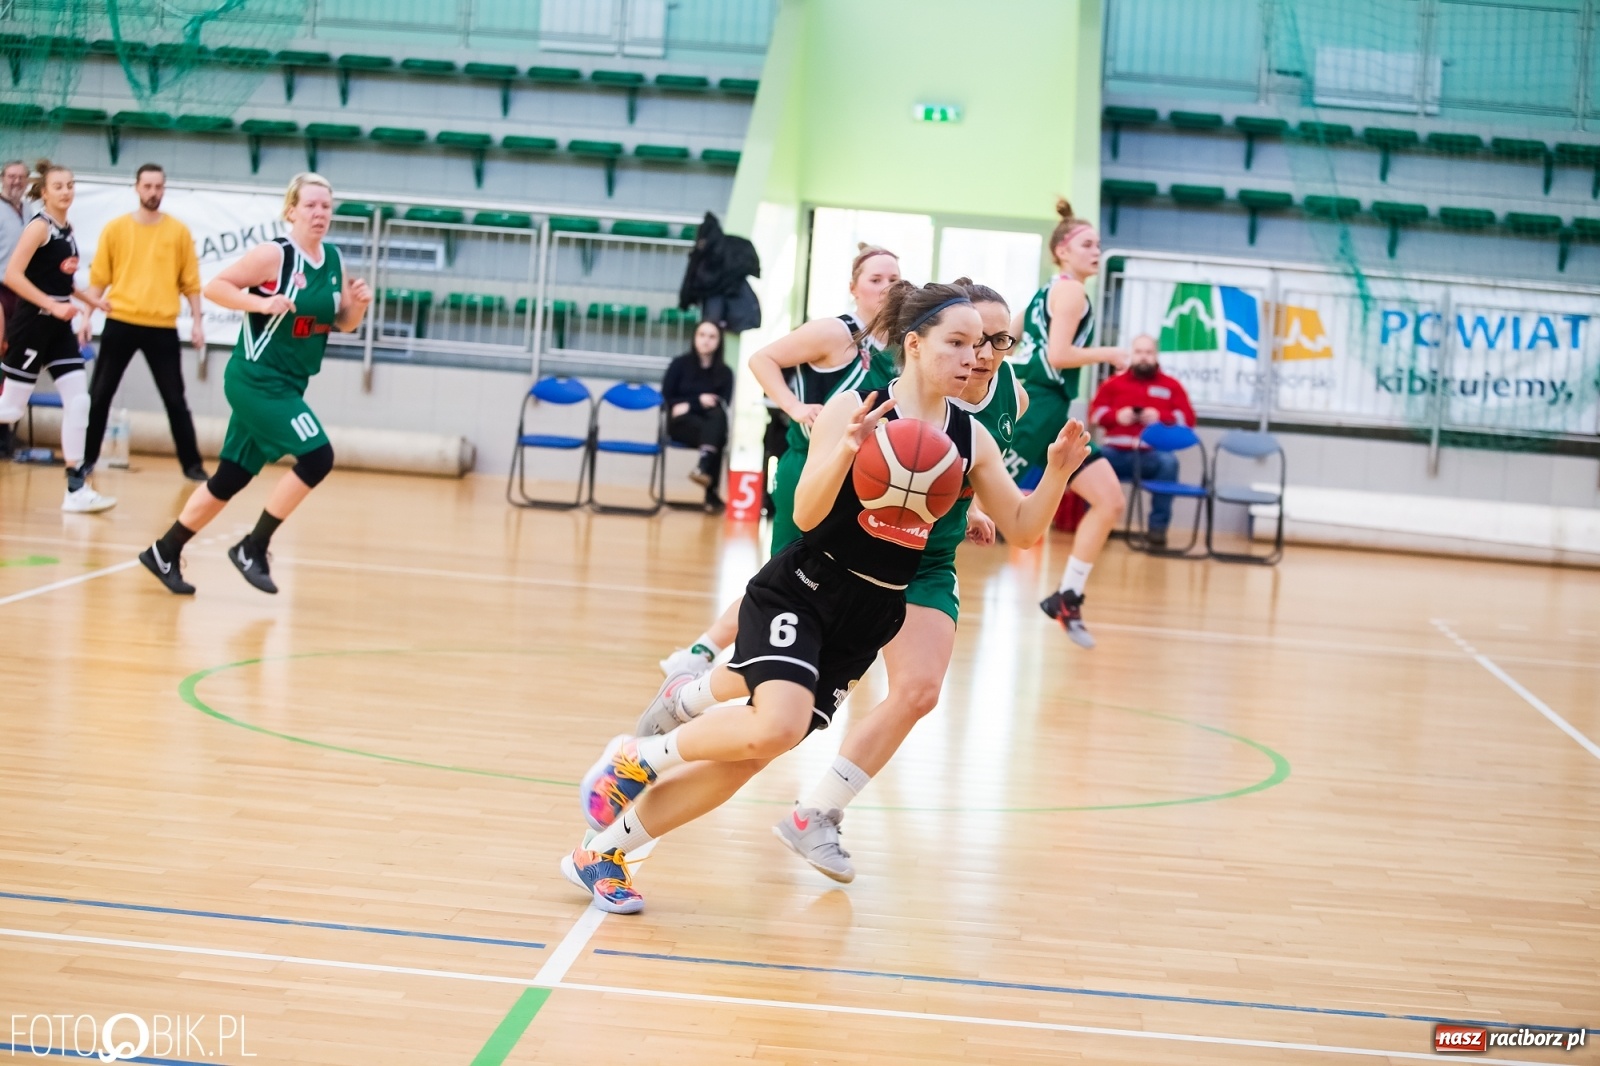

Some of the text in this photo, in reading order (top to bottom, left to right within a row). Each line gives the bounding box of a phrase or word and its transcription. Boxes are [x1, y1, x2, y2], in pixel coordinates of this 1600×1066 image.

[22, 348, 38, 370] 7
[290, 412, 319, 442] 10
[732, 474, 759, 510] 5
[795, 568, 820, 591] SPALDING
[769, 612, 799, 648] 6
